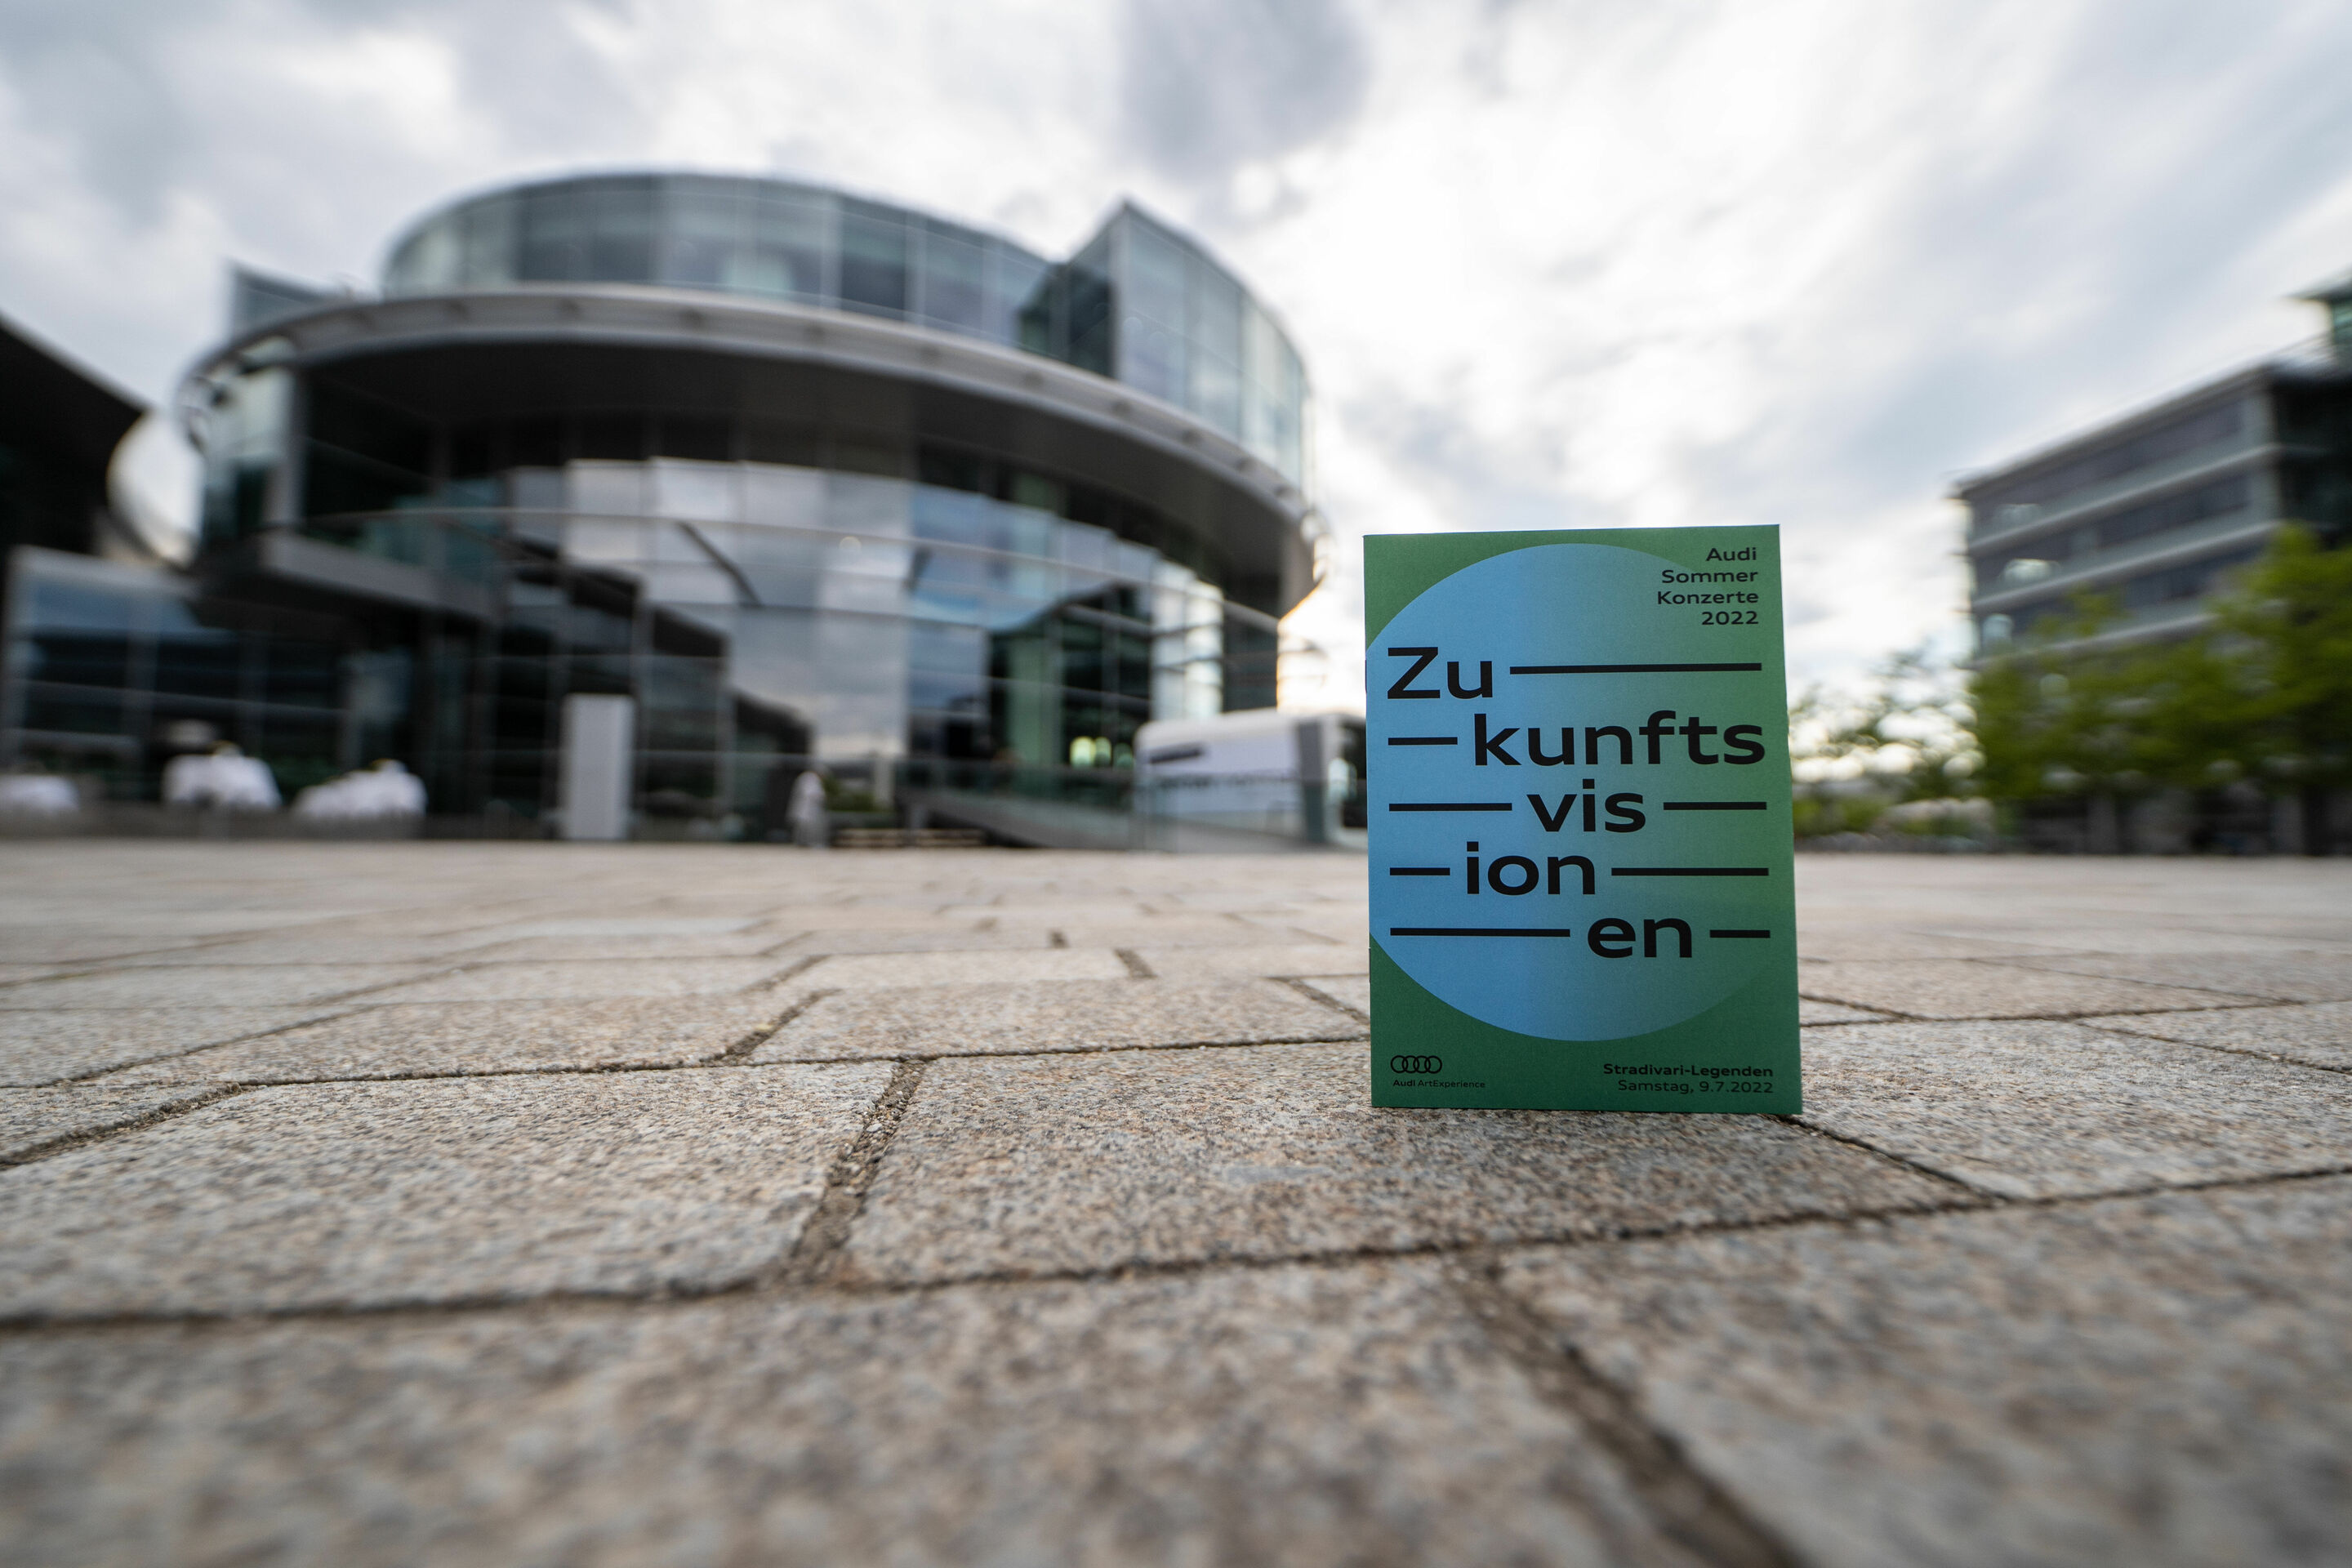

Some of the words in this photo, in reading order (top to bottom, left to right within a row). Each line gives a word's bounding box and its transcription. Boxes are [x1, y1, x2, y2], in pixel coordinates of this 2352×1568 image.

[1706, 547, 1757, 561] Audi
[1661, 569, 1758, 584] Sommer
[1657, 590, 1759, 604] Konzerte
[1701, 611, 1759, 625] 2022
[1387, 646, 1494, 700] Zu
[1473, 710, 1766, 766] kunfts
[1526, 778, 1646, 833] vis
[1466, 841, 1596, 896] ion
[1587, 917, 1693, 959] en
[1603, 1063, 1773, 1078] Stradivari-Legenden
[1417, 1080, 1486, 1089] ArtExperience
[1618, 1080, 1695, 1094] Samstag,
[1699, 1081, 1775, 1094] 9.7.2022
